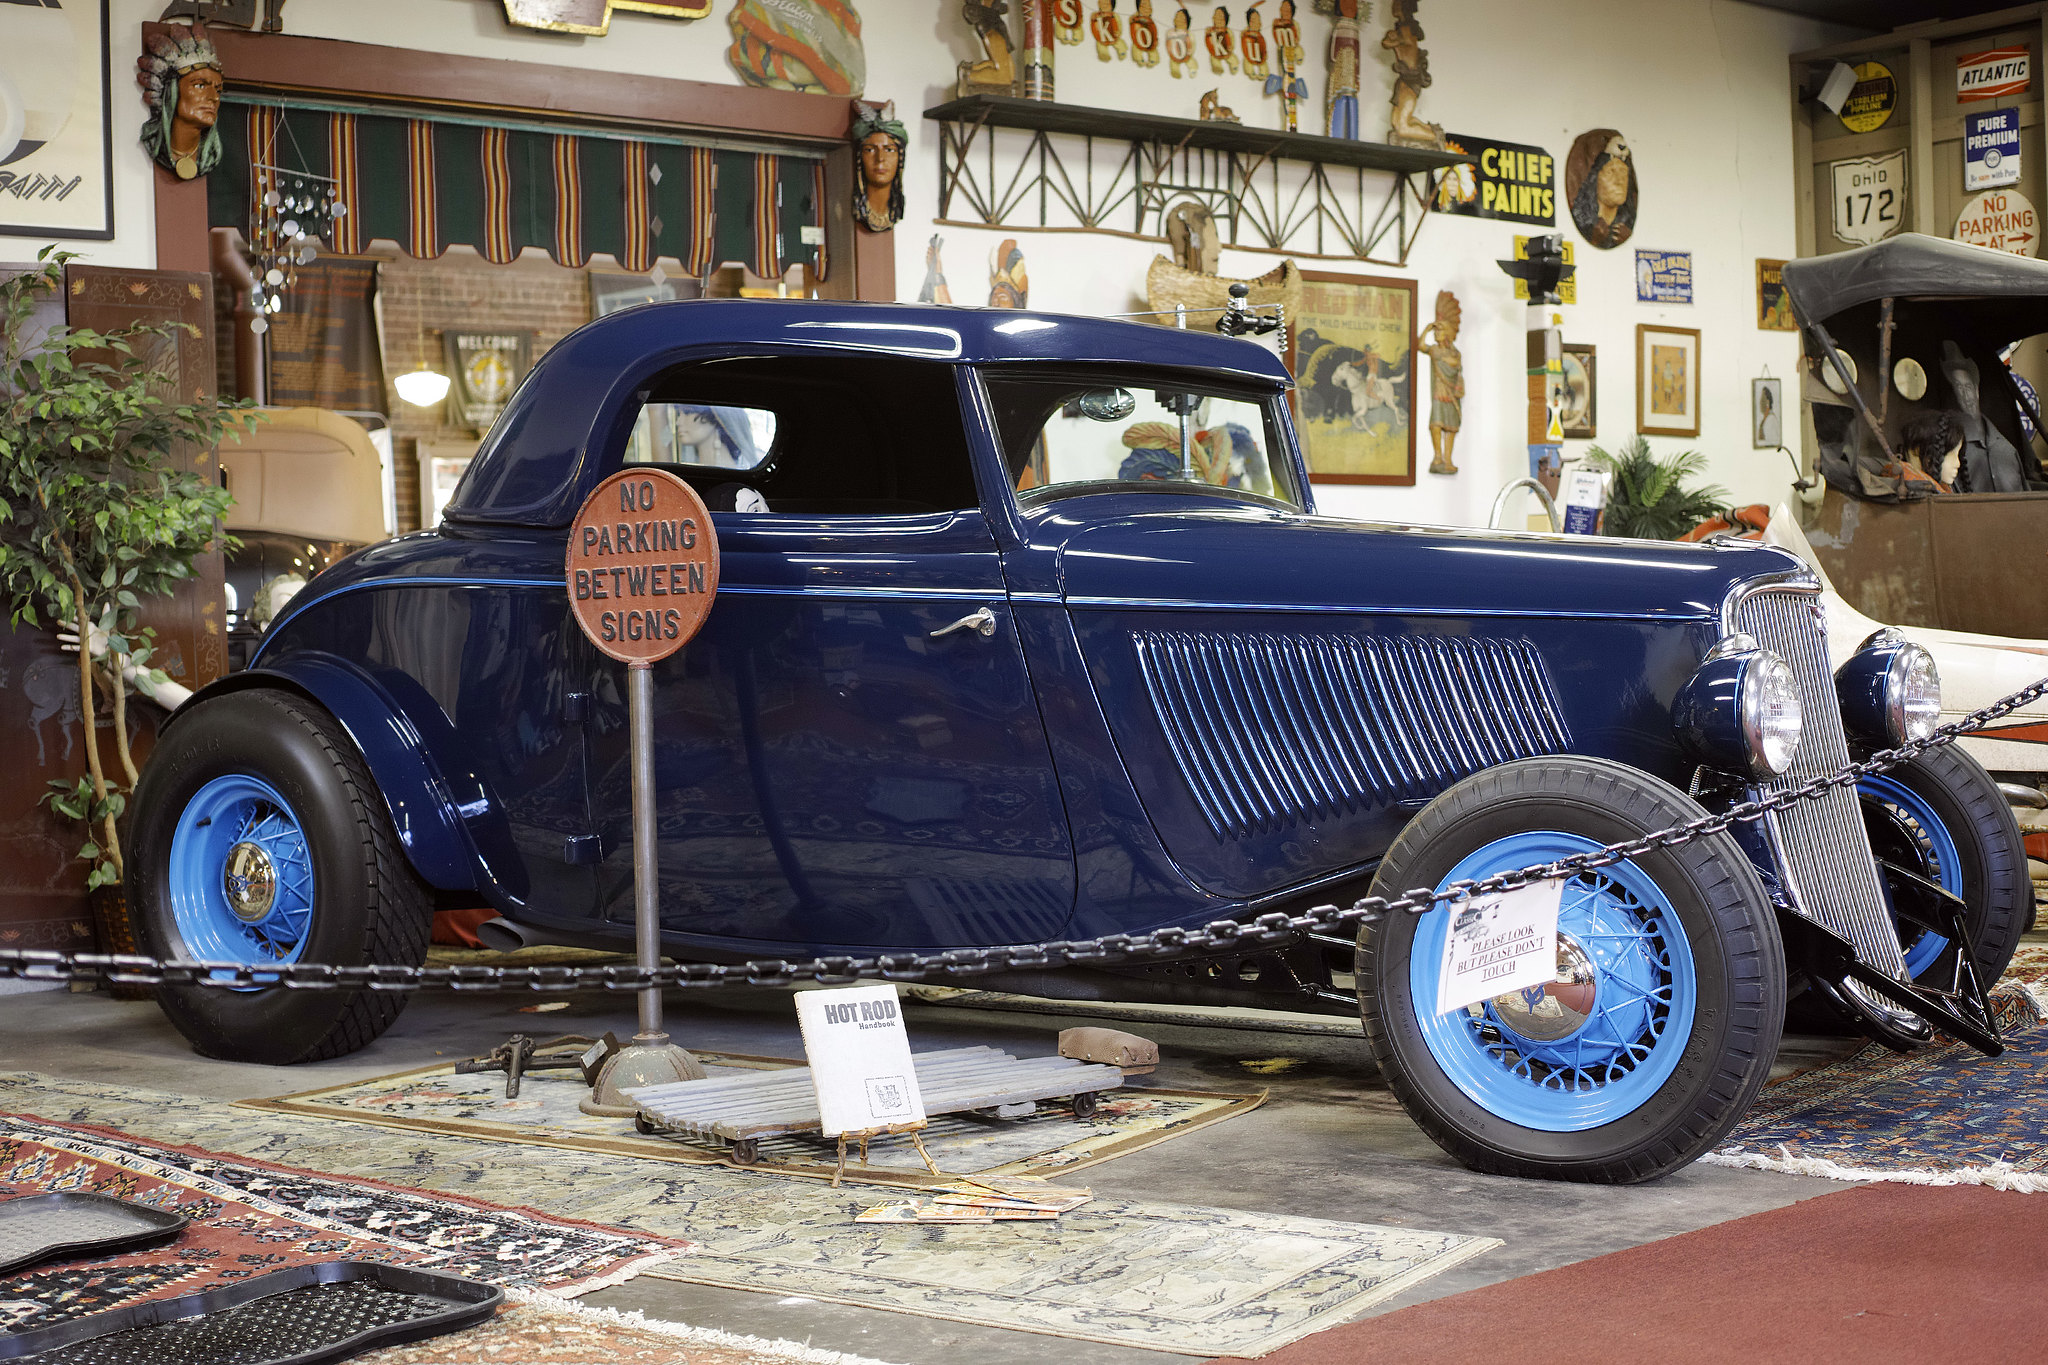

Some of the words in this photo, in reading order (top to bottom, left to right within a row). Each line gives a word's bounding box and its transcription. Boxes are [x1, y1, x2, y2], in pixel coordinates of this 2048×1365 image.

[1962, 61, 2026, 86] ATLANTIC
[1977, 115, 2007, 133] PURE
[1968, 129, 2018, 150] PREMIUM
[1481, 147, 1552, 184] CHIEF
[1852, 170, 1887, 187] OHIO
[1482, 180, 1554, 218] PAINTS
[1846, 188, 1894, 226] 172
[1984, 195, 2006, 214] NO
[1960, 209, 2033, 238] PARKING
[1990, 234, 2006, 248] AT
[1302, 286, 1348, 316] RED
[1353, 290, 1404, 320] MAN
[1302, 316, 1317, 328] THE
[1319, 318, 1340, 330] MILD
[1342, 319, 1377, 331] MELLOW
[1379, 322, 1401, 333] CHEW
[457, 335, 519, 350] WELCOME
[620, 481, 654, 512] NO
[583, 518, 696, 556] PARKING
[576, 562, 705, 600] BETWEEN
[601, 608, 681, 642] SIGNS
[1472, 933, 1506, 953] PLEASE
[1508, 924, 1535, 941] LOOK
[1457, 960, 1477, 973] BUT
[1478, 946, 1514, 966] PLEASE
[1515, 936, 1546, 954] DON'T
[1482, 960, 1516, 979] TOUCH
[824, 1003, 858, 1024] HOT
[860, 999, 897, 1022] ROD
[859, 1020, 896, 1030] Handbook
